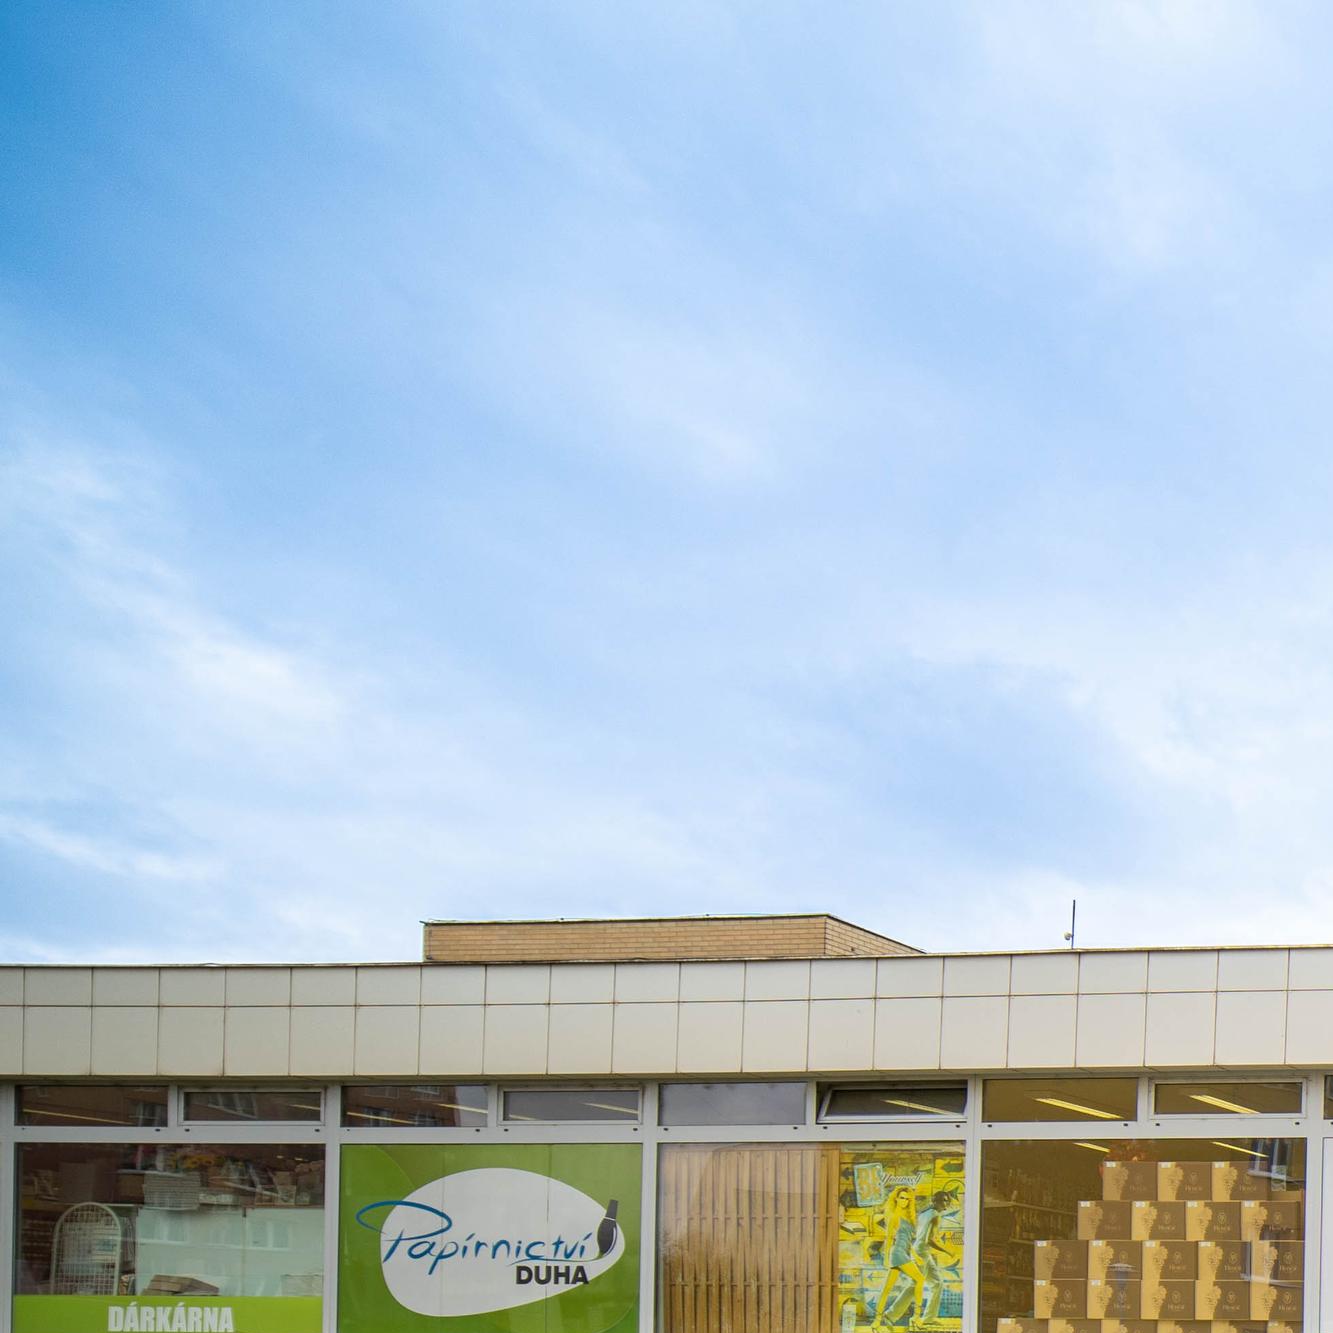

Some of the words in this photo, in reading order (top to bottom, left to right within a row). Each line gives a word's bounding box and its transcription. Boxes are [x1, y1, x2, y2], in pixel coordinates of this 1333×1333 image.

[356, 1200, 593, 1276] Papírnictví
[515, 1265, 589, 1285] DUHA
[108, 1301, 234, 1333] DÁRKÁRNA
